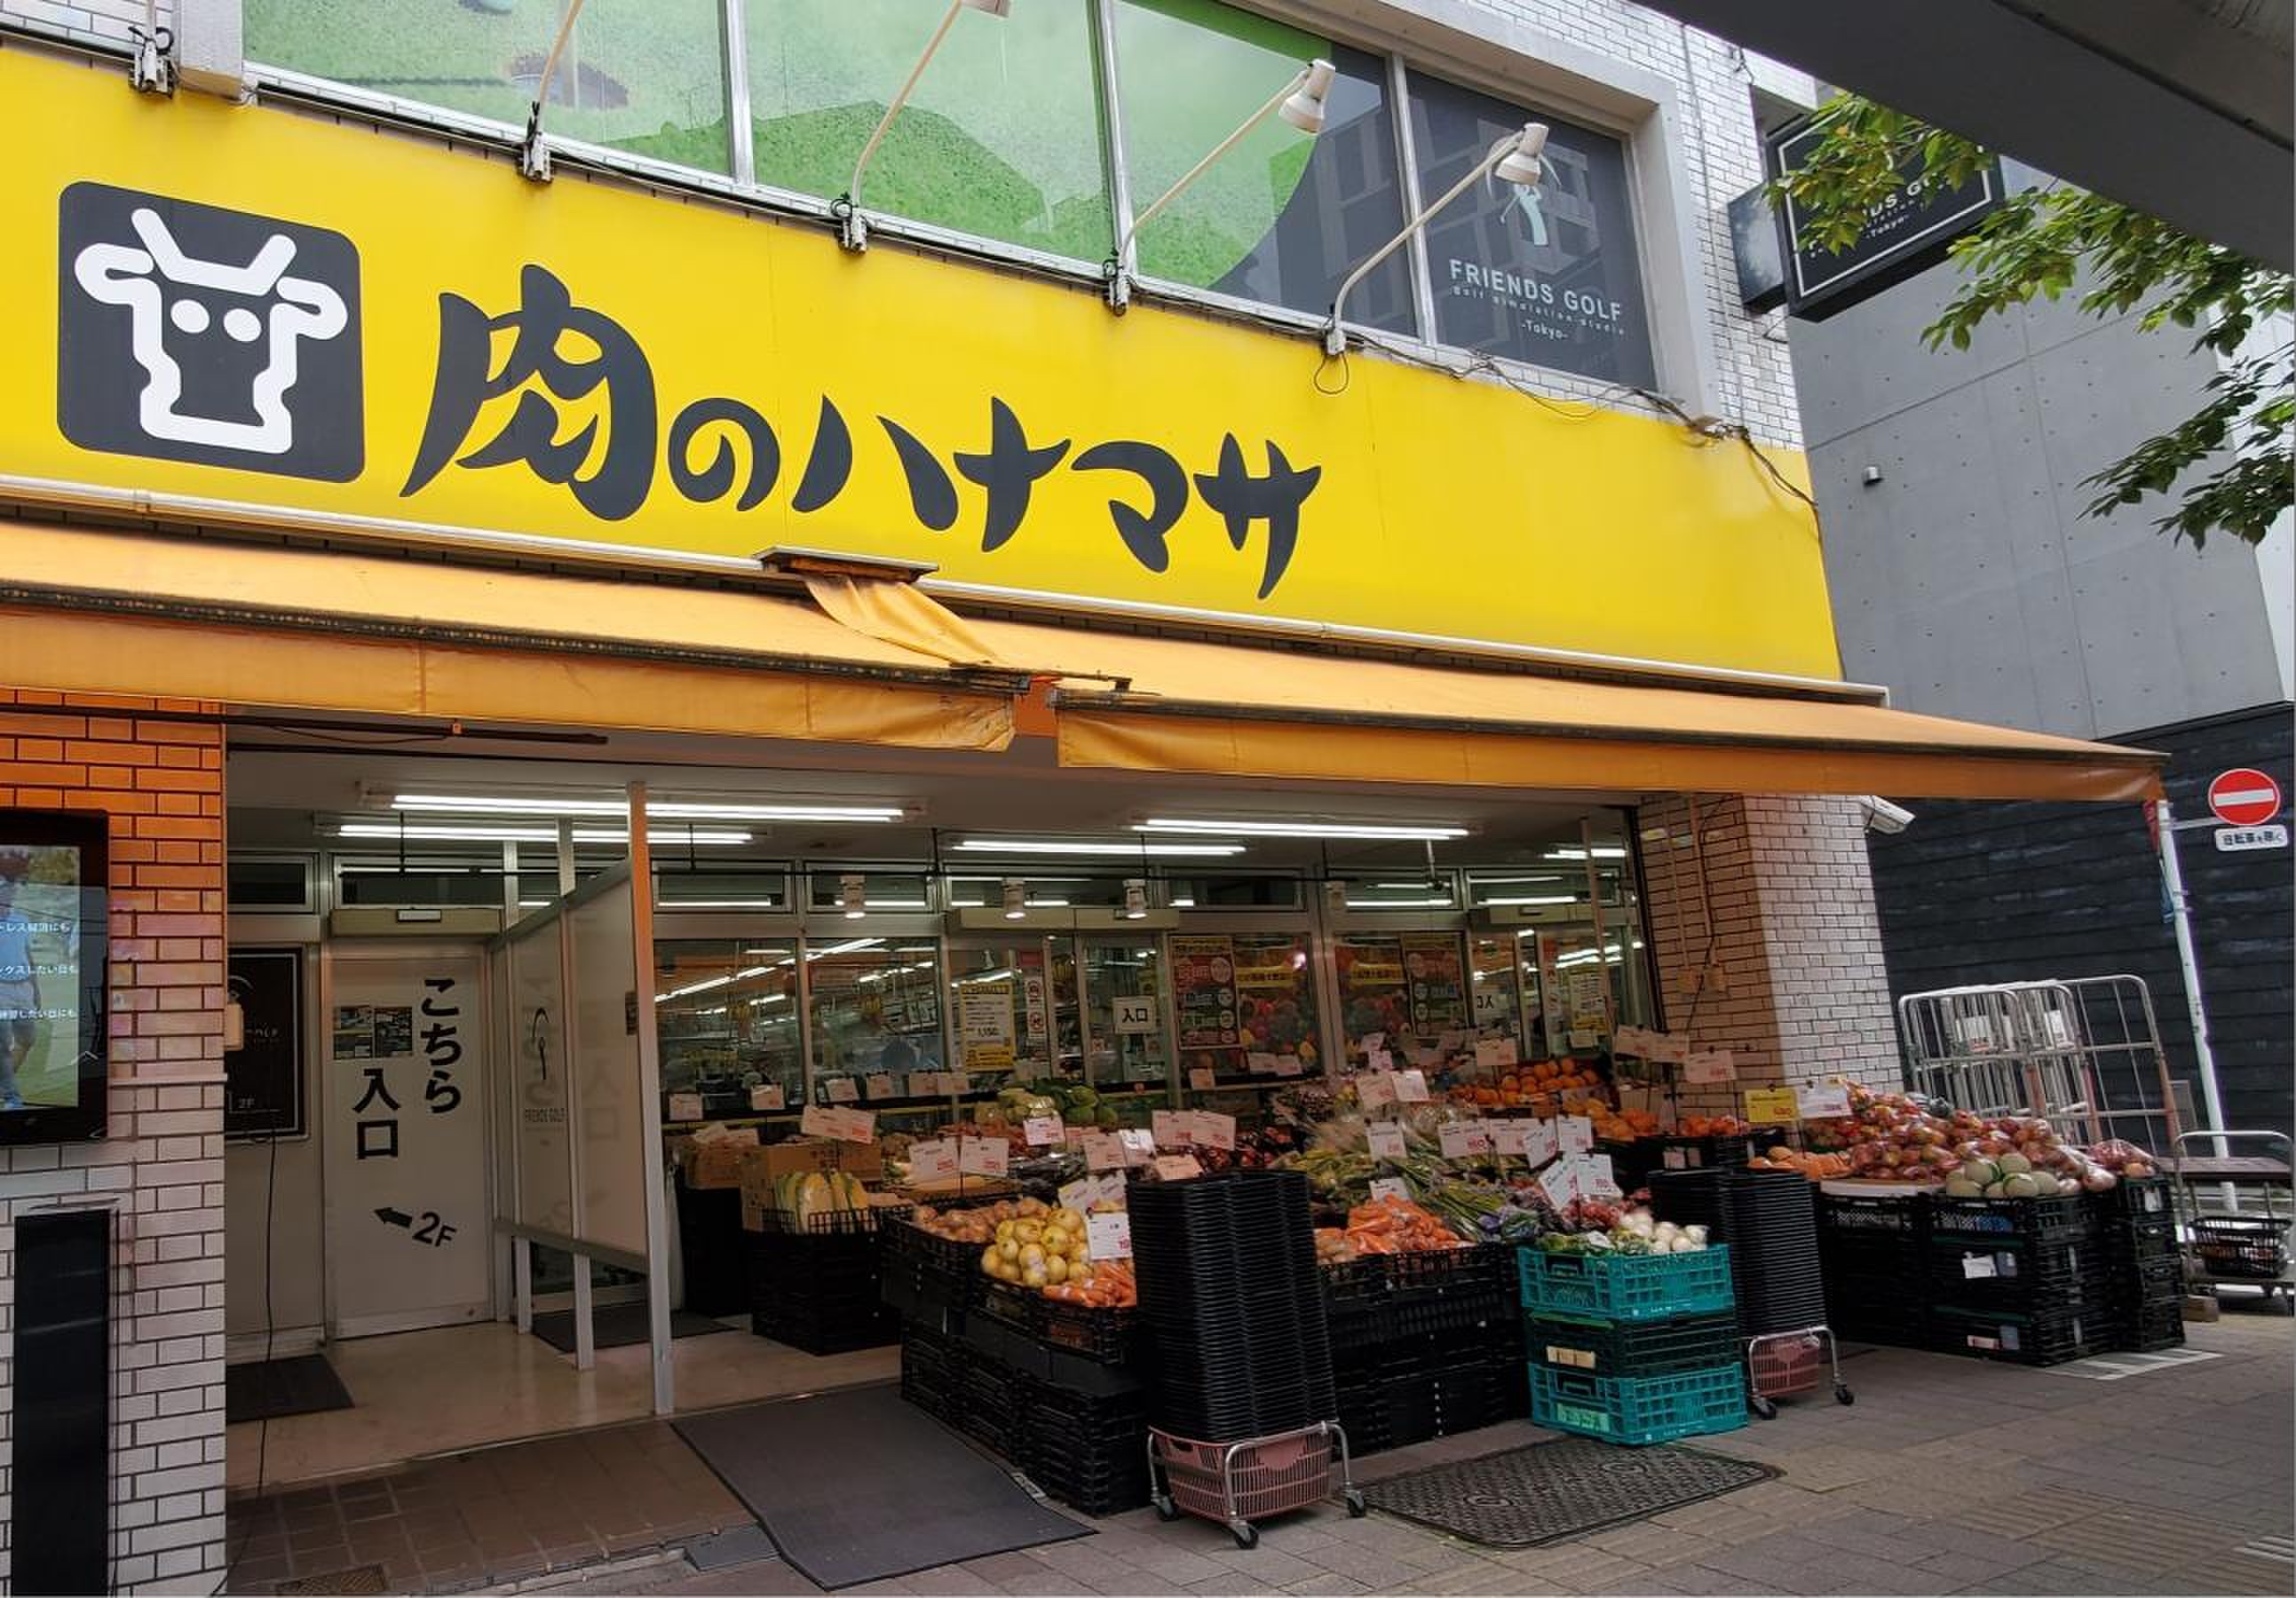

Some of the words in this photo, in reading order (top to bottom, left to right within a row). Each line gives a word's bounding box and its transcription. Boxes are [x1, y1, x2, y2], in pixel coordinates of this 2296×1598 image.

[1449, 258, 1554, 305] FRIENDS
[1564, 290, 1620, 321] GOLF
[400, 264, 1322, 600] 肉のハナマサ
[421, 978, 462, 1114] こちら
[1122, 1008, 1148, 1023] 入口
[352, 1068, 400, 1160] 入口
[412, 1211, 457, 1247] 2F
